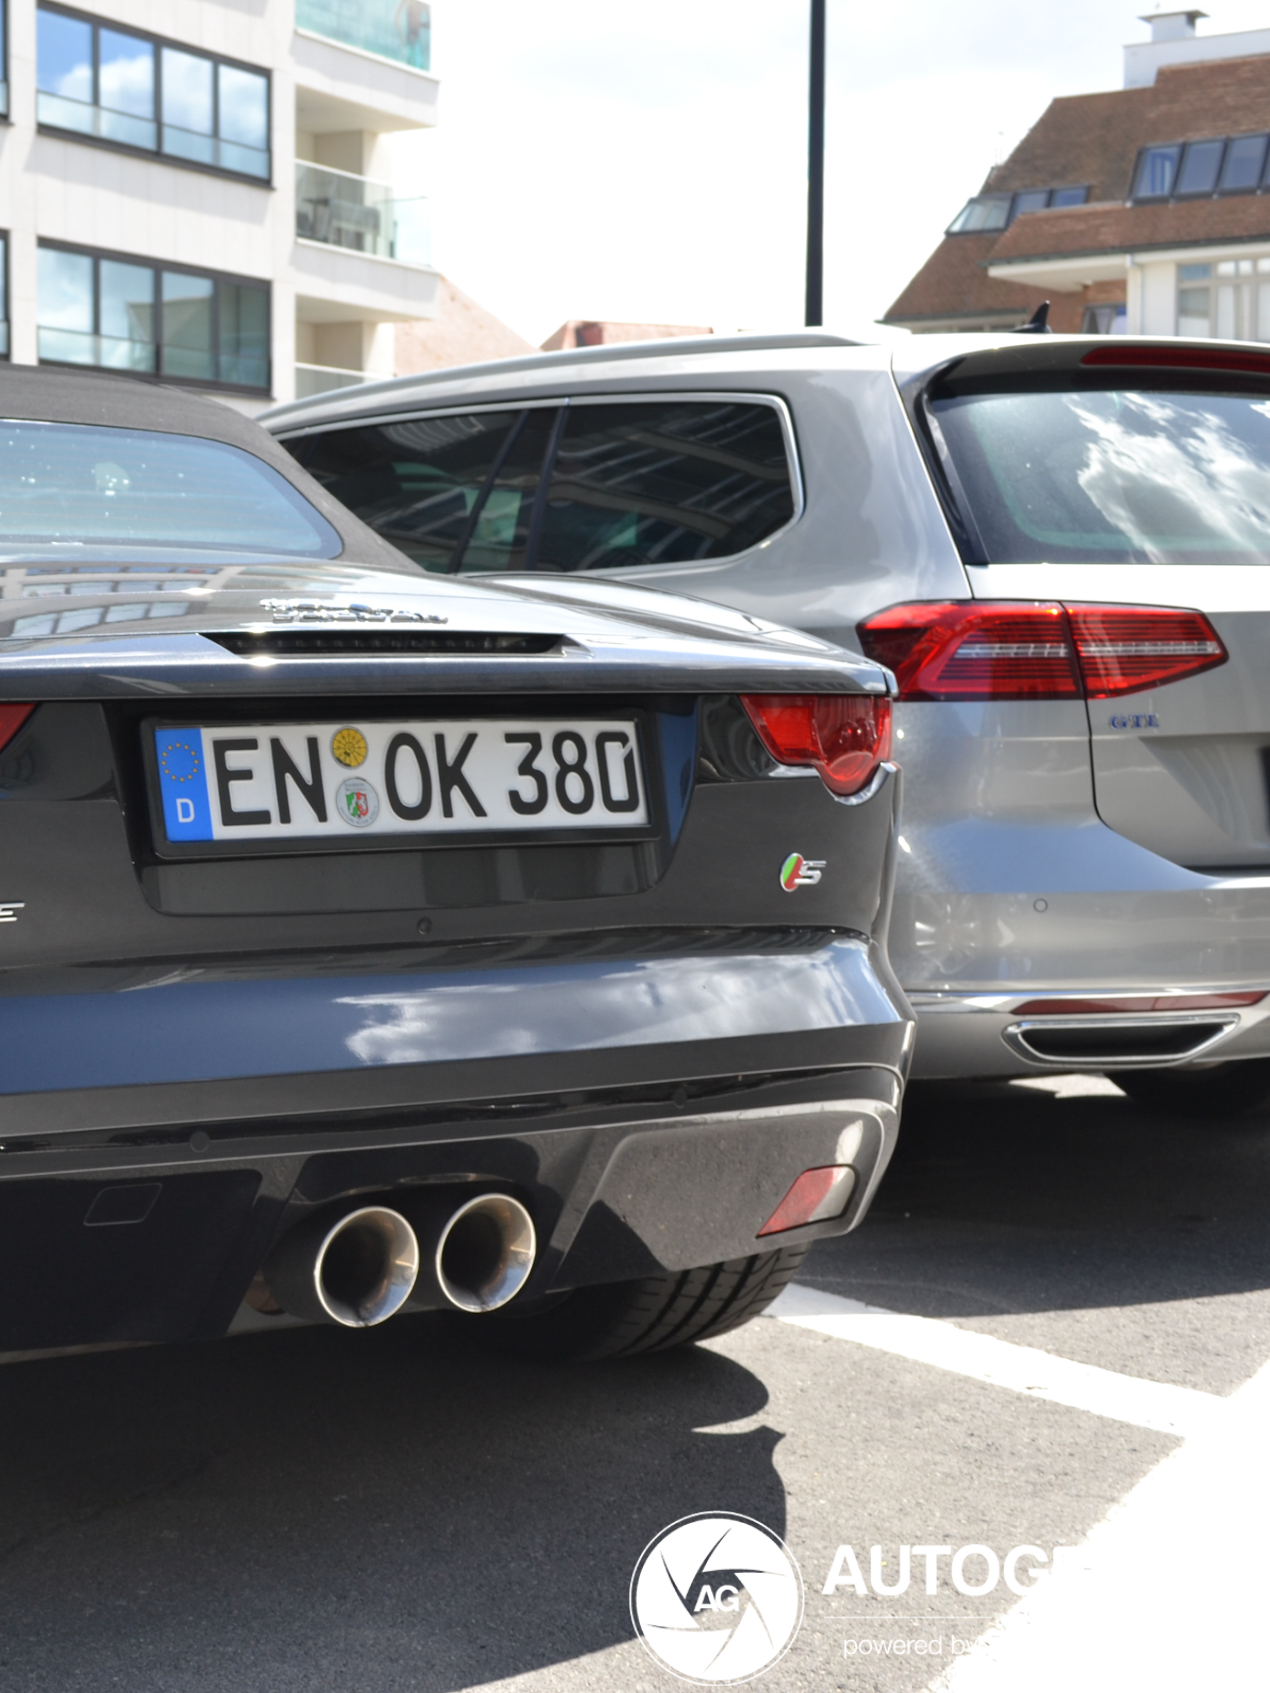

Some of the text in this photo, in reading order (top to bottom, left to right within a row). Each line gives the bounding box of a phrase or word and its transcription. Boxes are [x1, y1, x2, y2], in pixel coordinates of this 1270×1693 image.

[212, 731, 639, 827] EN OK 380
[176, 798, 195, 823] D
